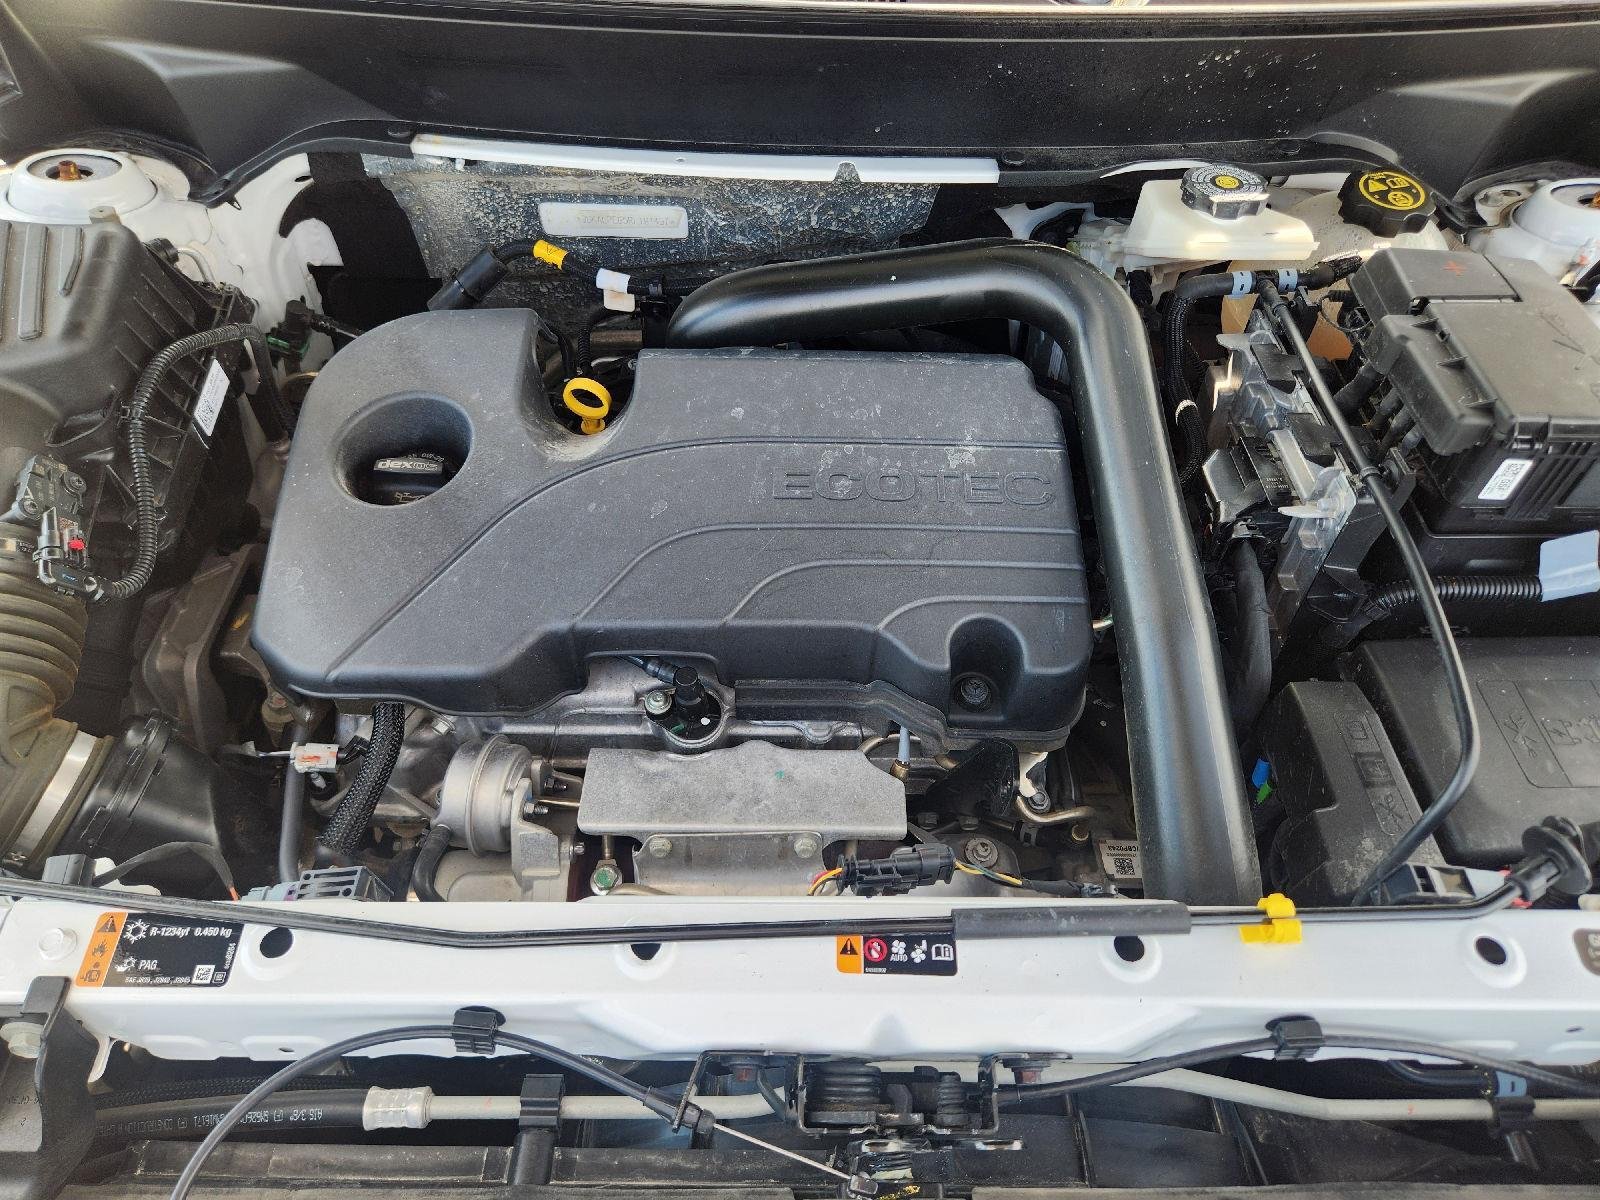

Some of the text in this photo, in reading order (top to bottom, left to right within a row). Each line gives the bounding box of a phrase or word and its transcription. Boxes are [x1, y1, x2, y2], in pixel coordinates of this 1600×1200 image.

[773, 467, 1054, 506] ECOTEC
[149, 926, 232, 939] R-1234yf 0.450 kg
[890, 953, 908, 962] AUTO
[138, 959, 158, 970] PAG
